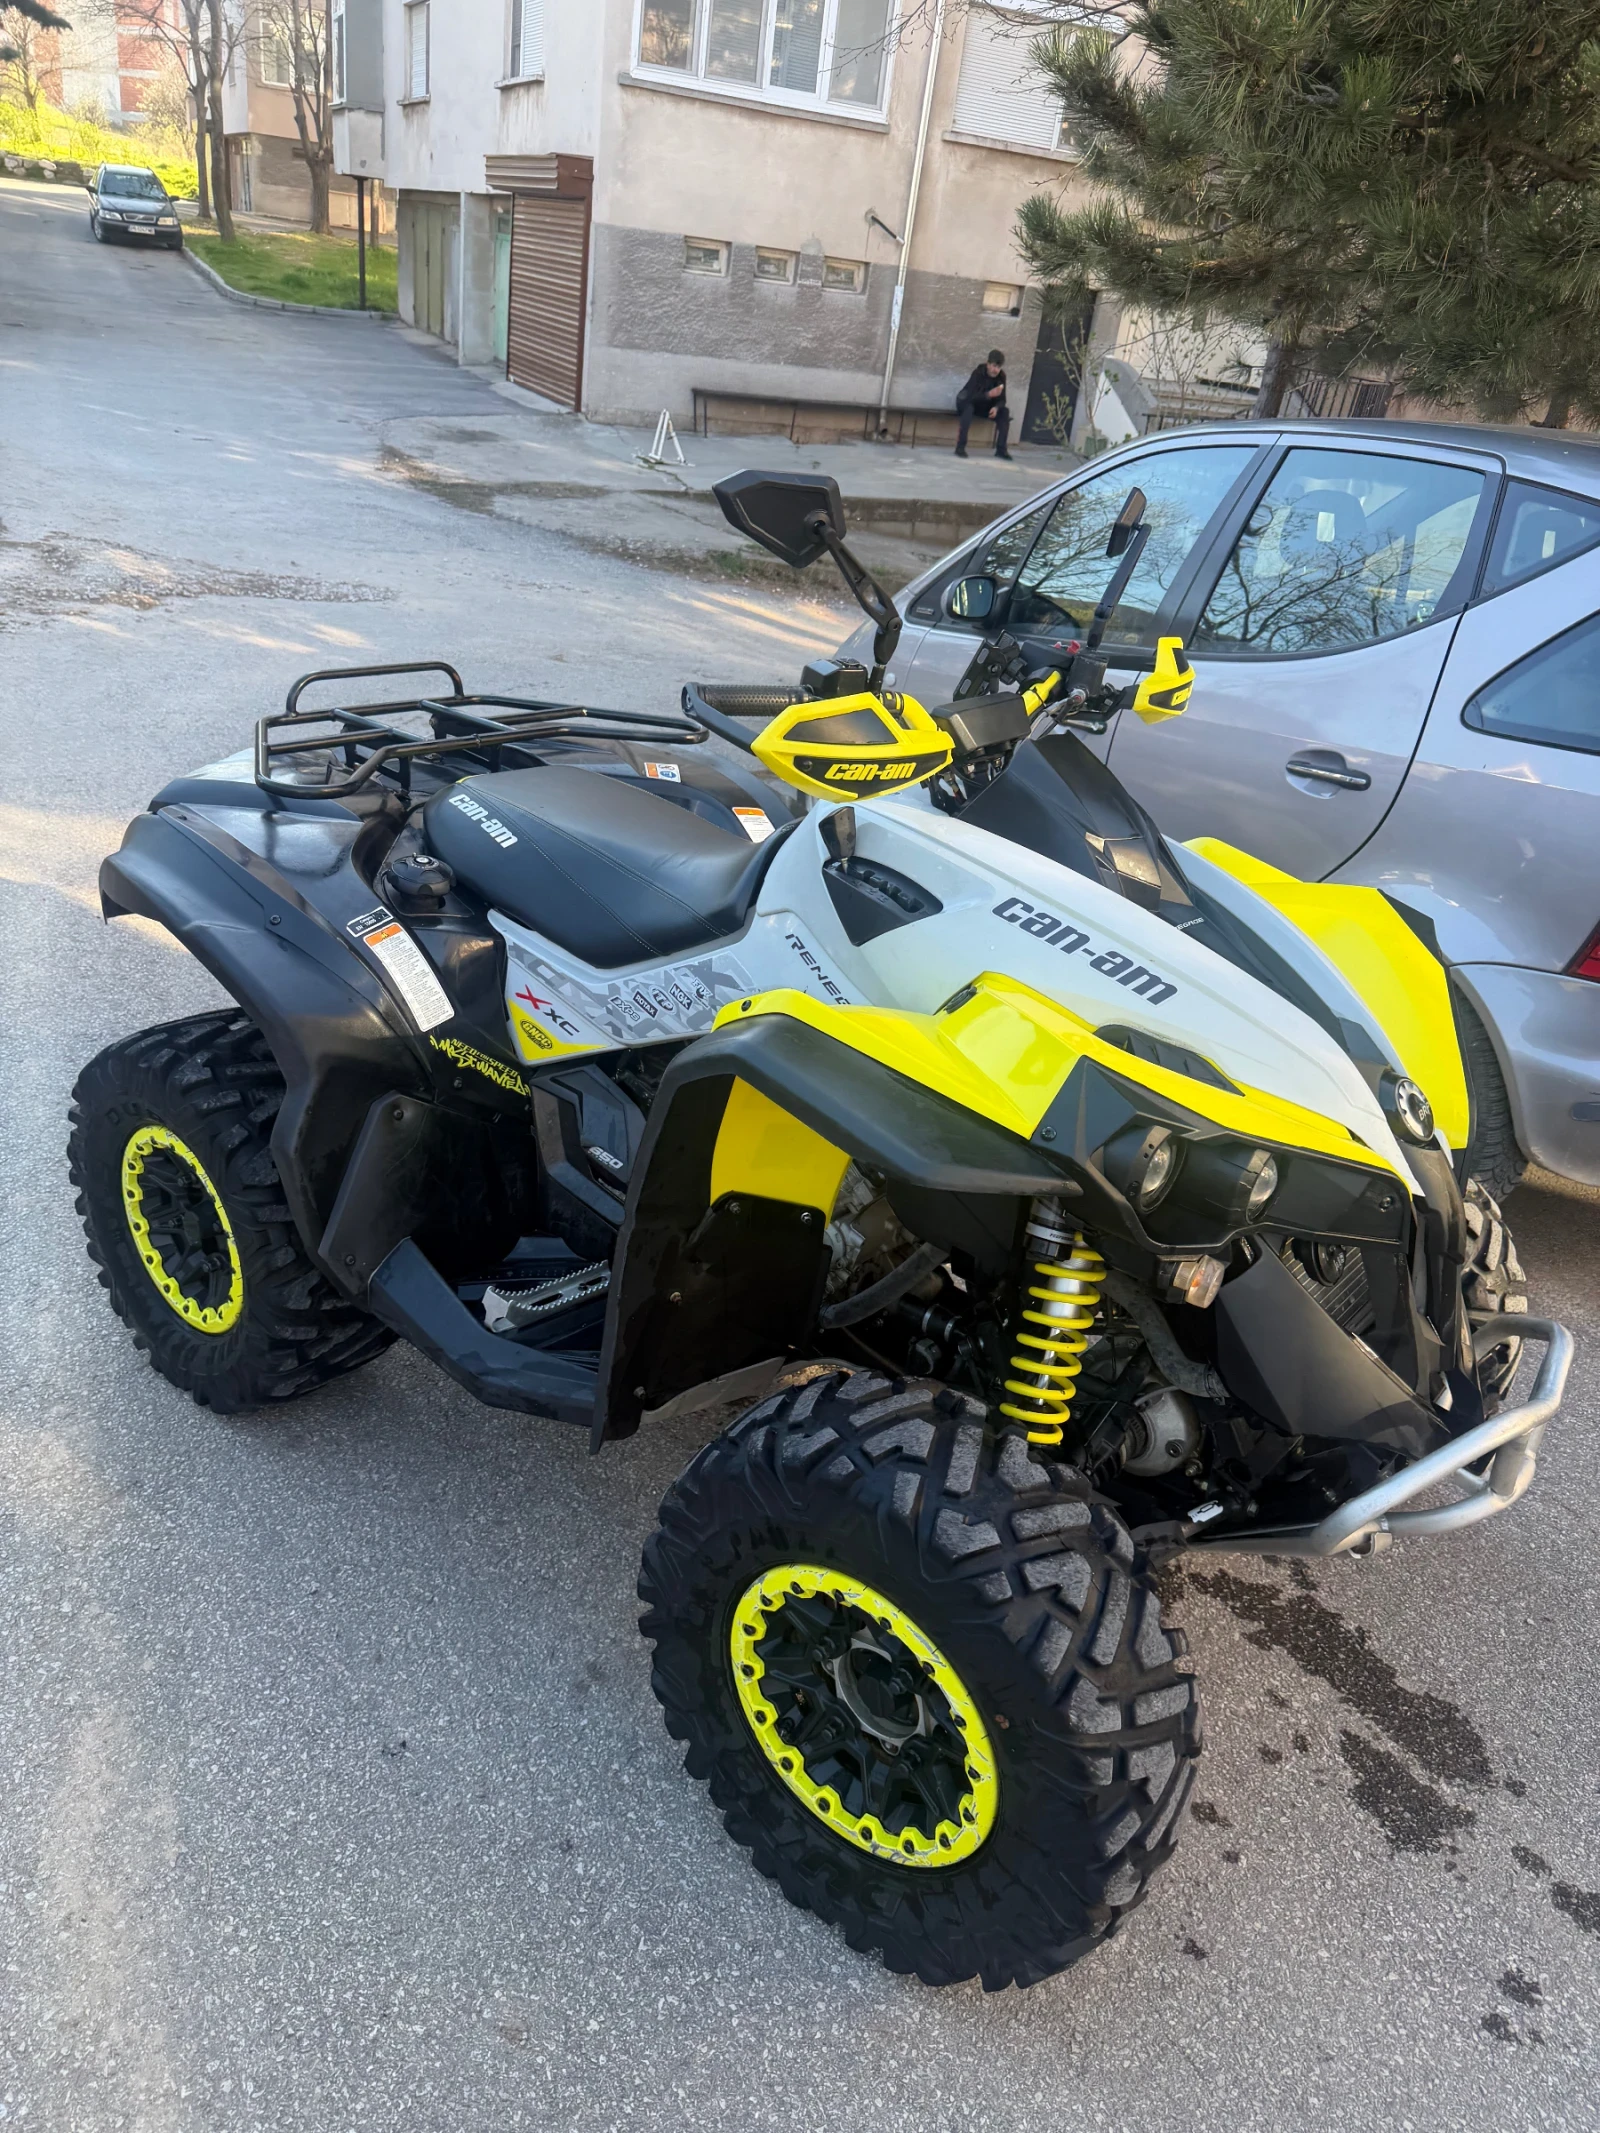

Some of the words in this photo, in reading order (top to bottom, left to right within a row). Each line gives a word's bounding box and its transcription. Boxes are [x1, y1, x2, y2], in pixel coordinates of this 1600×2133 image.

[824, 762, 917, 781] can-am
[449, 793, 518, 848] can-am
[992, 897, 1178, 1006] can-am
[515, 984, 552, 1010] X
[635, 993, 656, 1016] ROTAX
[650, 987, 675, 1012] ITP
[670, 985, 690, 1009] NGK
[616, 1001, 641, 1022] XPS
[521, 1021, 551, 1047] GNCC
[451, 1039, 477, 1056] NEED
[488, 1058, 518, 1077] SPEED
[476, 1061, 527, 1096] WANTED
[589, 1146, 623, 1169] 650
